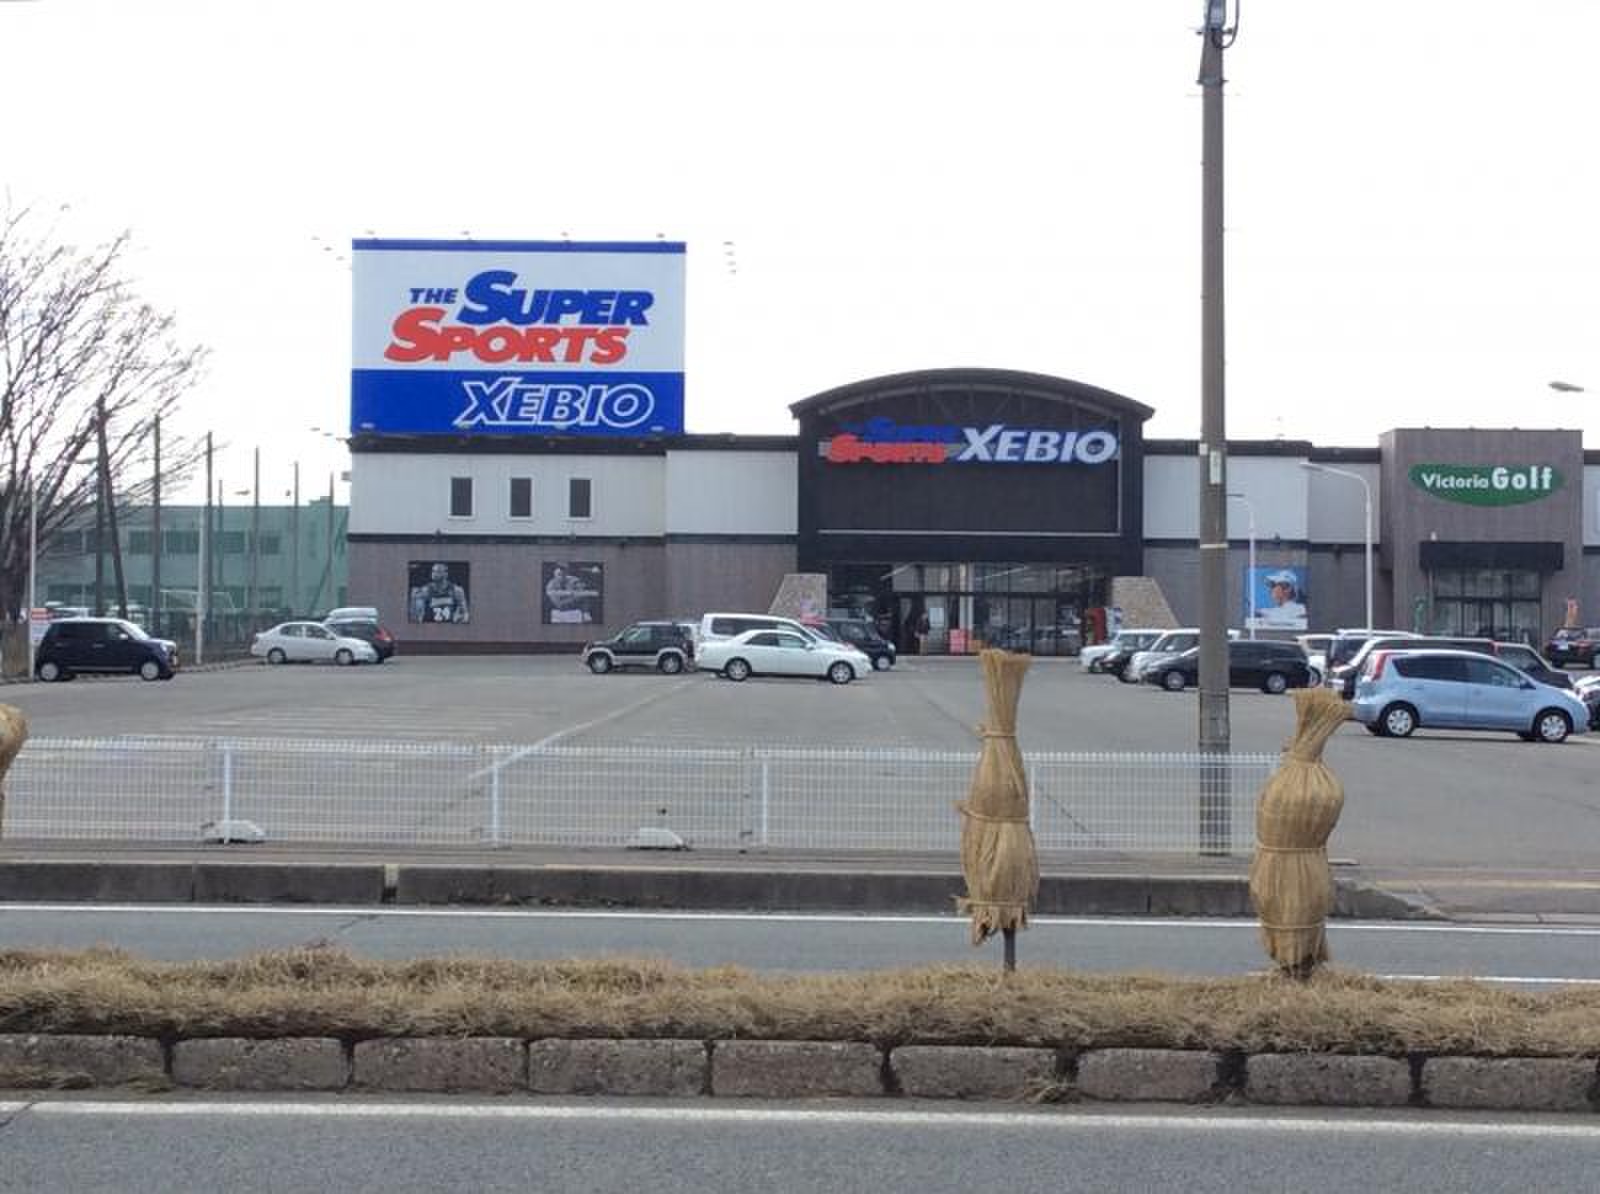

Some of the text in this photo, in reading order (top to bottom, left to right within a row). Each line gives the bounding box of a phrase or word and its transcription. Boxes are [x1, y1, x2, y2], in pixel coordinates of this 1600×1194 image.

[410, 269, 655, 326] THE SUPER
[384, 308, 629, 364] SPORTS
[453, 375, 655, 429] XEBIO
[959, 424, 1118, 463] XEBIO
[1421, 465, 1553, 490] Victoria Golf
